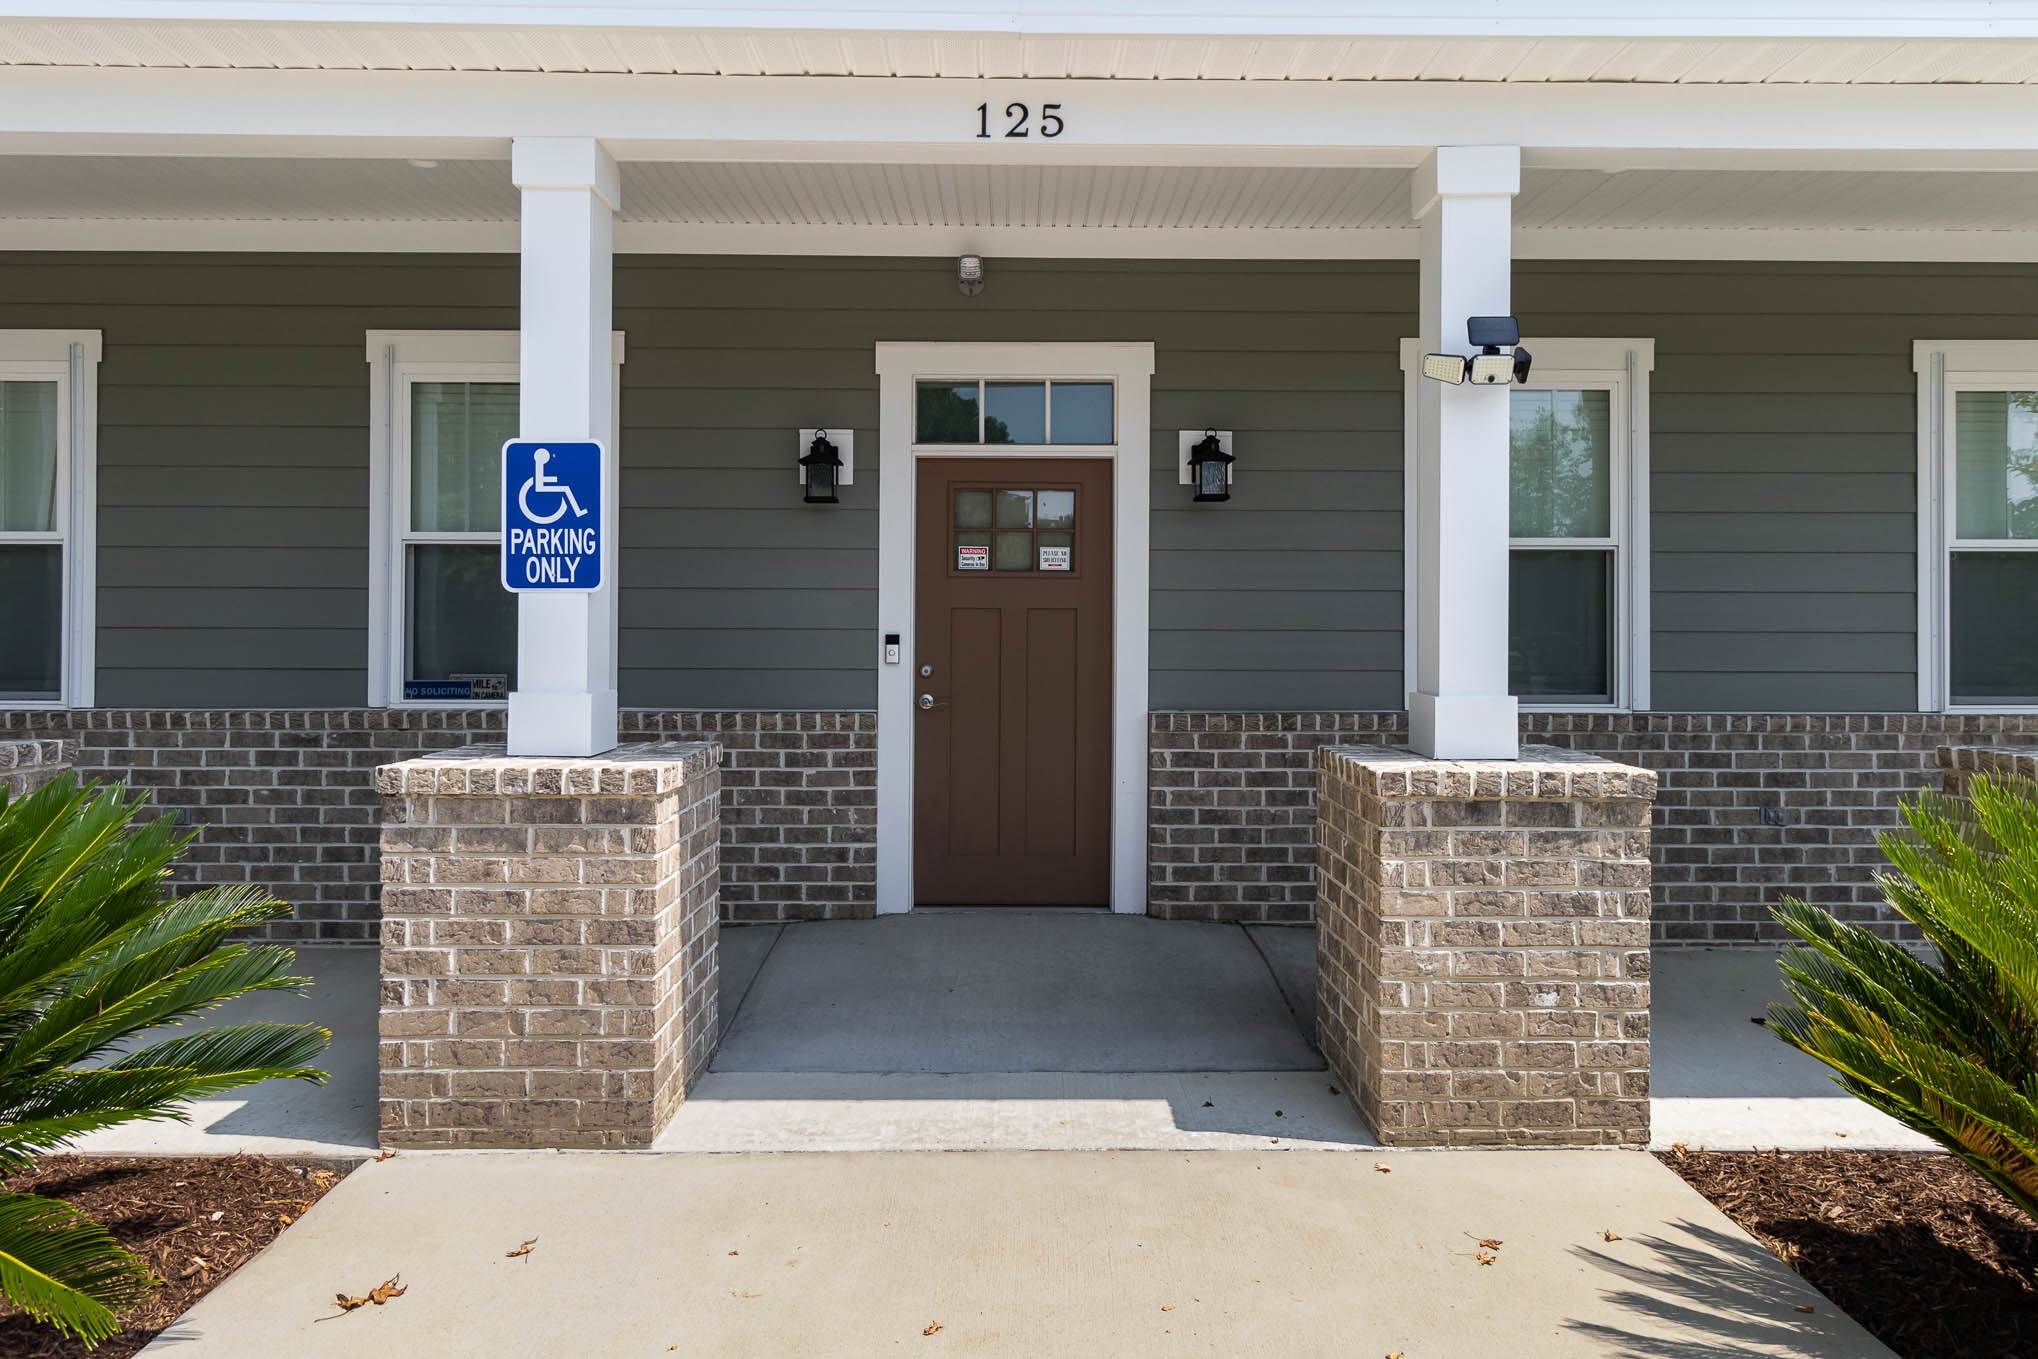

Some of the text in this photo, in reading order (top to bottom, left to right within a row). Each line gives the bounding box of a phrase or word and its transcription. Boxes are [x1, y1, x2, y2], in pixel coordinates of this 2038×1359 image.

[976, 102, 1064, 138] 125
[510, 527, 597, 555] PARKING
[526, 556, 582, 583] ONLY
[405, 687, 471, 696] NO SOLICITING
